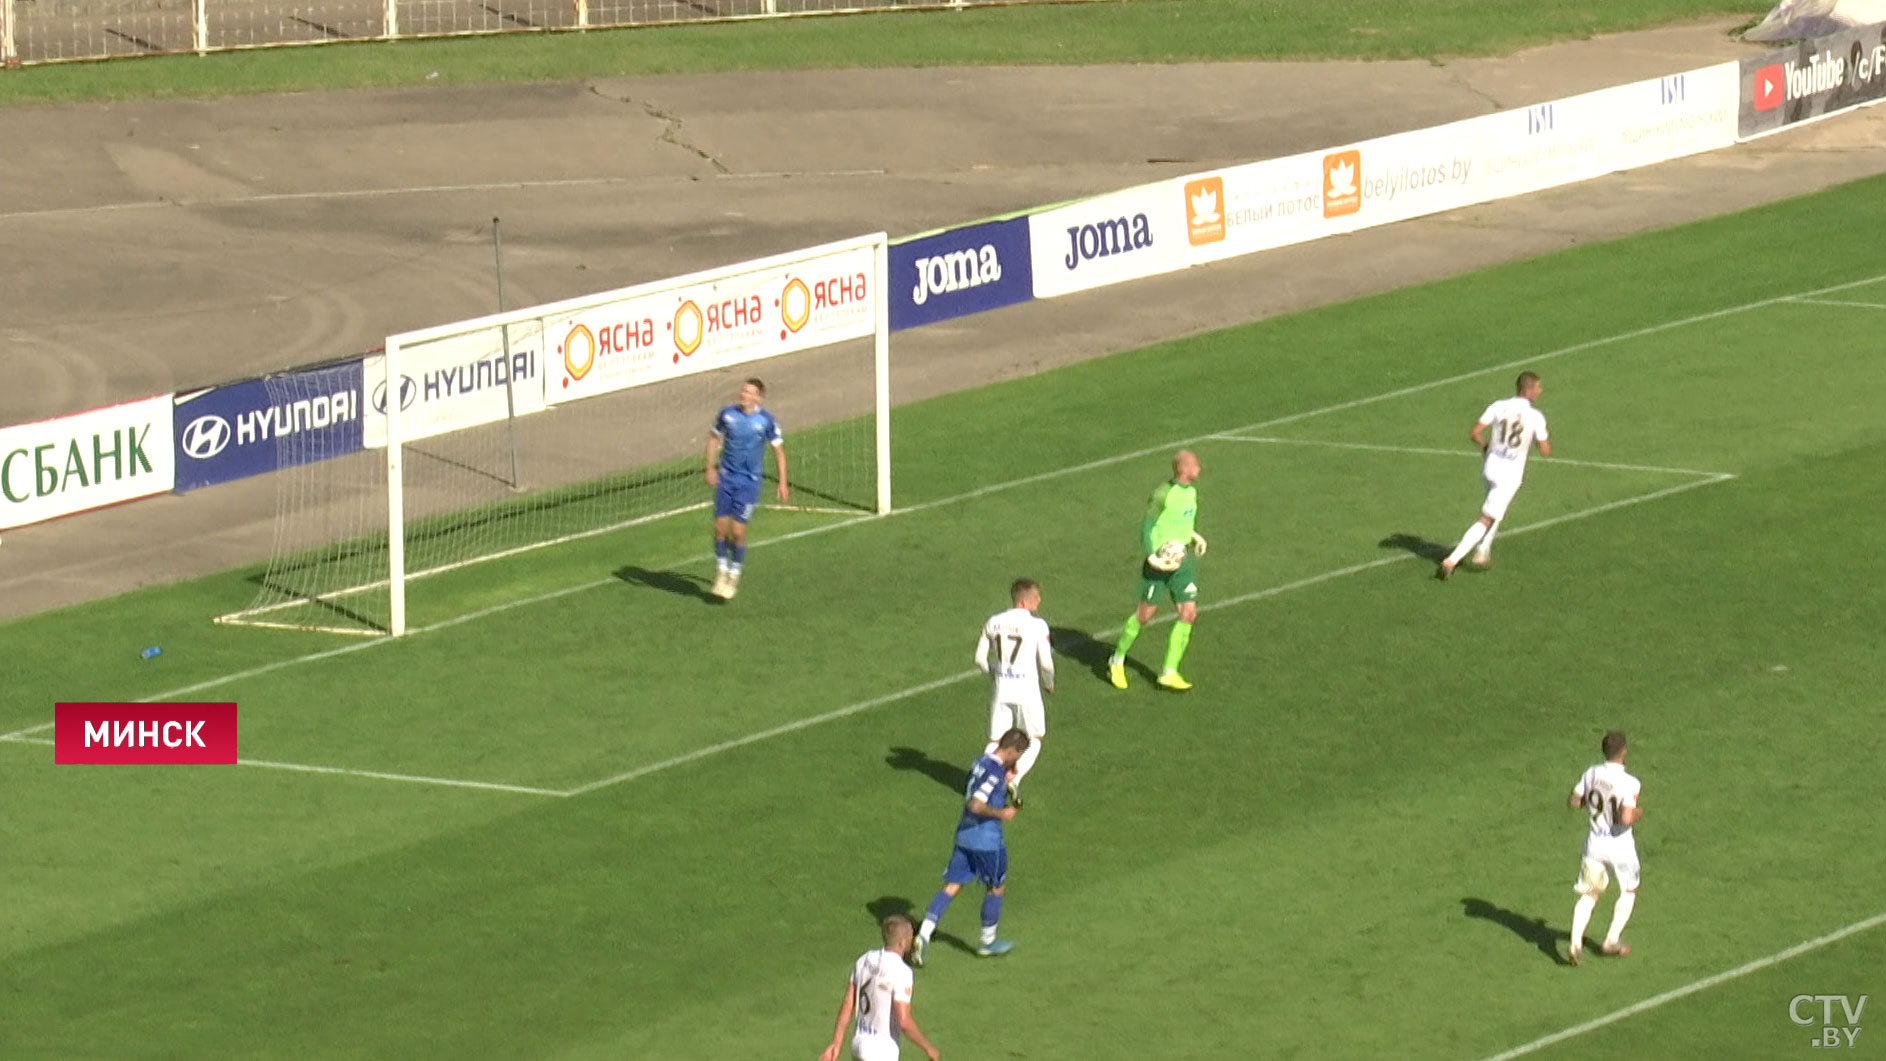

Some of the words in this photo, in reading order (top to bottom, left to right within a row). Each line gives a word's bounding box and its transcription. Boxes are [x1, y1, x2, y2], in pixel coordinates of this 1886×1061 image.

[1784, 50, 1844, 101] YouTube
[1851, 44, 1886, 86] /c/F
[1363, 156, 1472, 200] belyilotos.by
[1065, 212, 1153, 271] Joma
[912, 243, 1002, 305] Joma
[424, 350, 535, 402] HYUNDAI
[236, 390, 358, 446] HYUNDAI
[1498, 418, 1524, 449] 18
[1, 422, 154, 503] СБАНК
[994, 634, 1023, 666] 17
